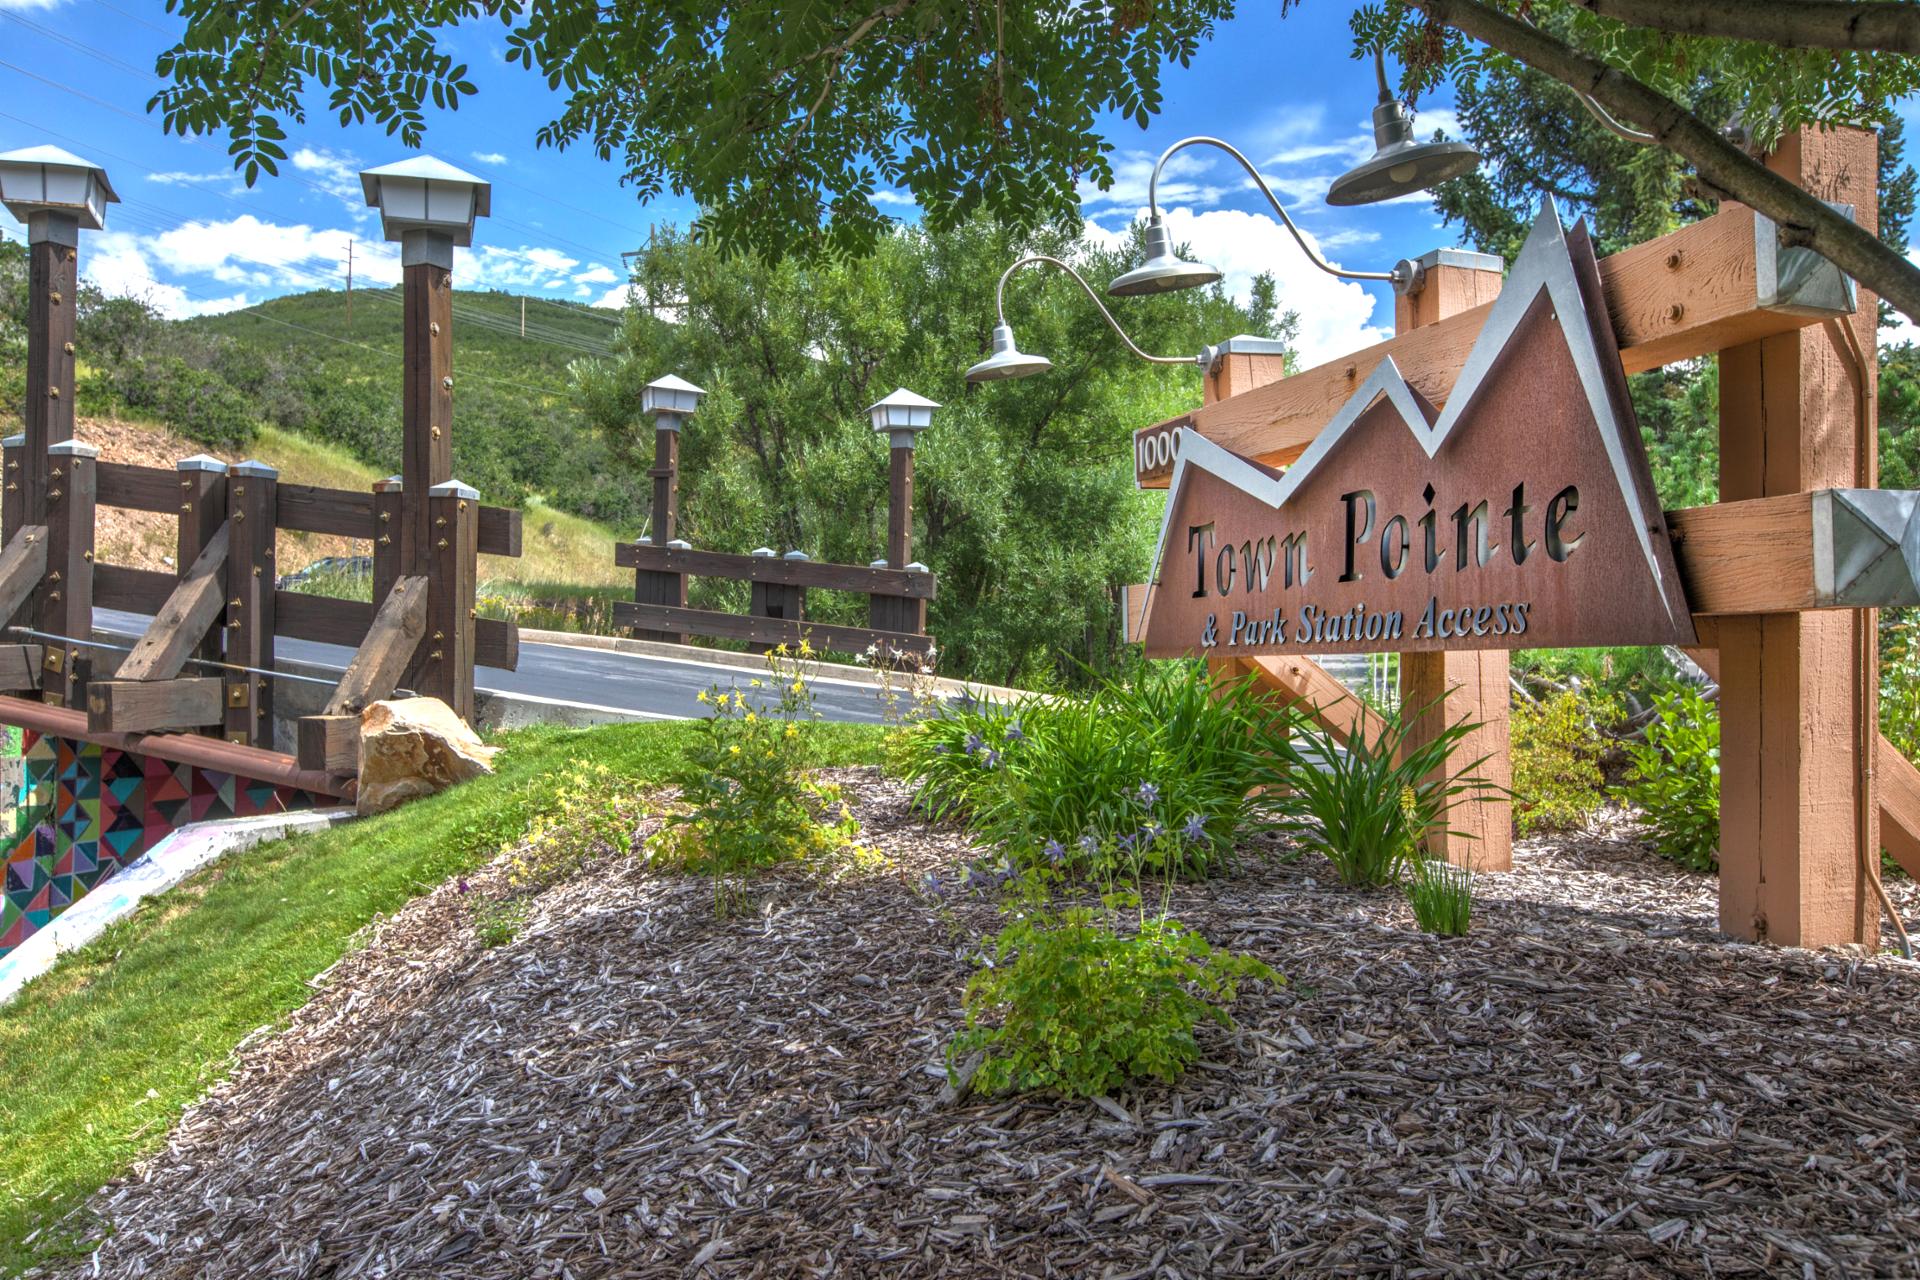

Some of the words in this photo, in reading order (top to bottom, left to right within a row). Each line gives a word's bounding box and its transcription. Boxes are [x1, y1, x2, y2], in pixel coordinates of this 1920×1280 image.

[1138, 427, 1182, 472] 1000
[1187, 520, 1315, 599] Town
[1338, 480, 1587, 583] Pointe
[1200, 613, 1219, 648] &
[1228, 606, 1288, 646] Park
[1295, 602, 1403, 643] Station
[1413, 595, 1531, 640] Access
